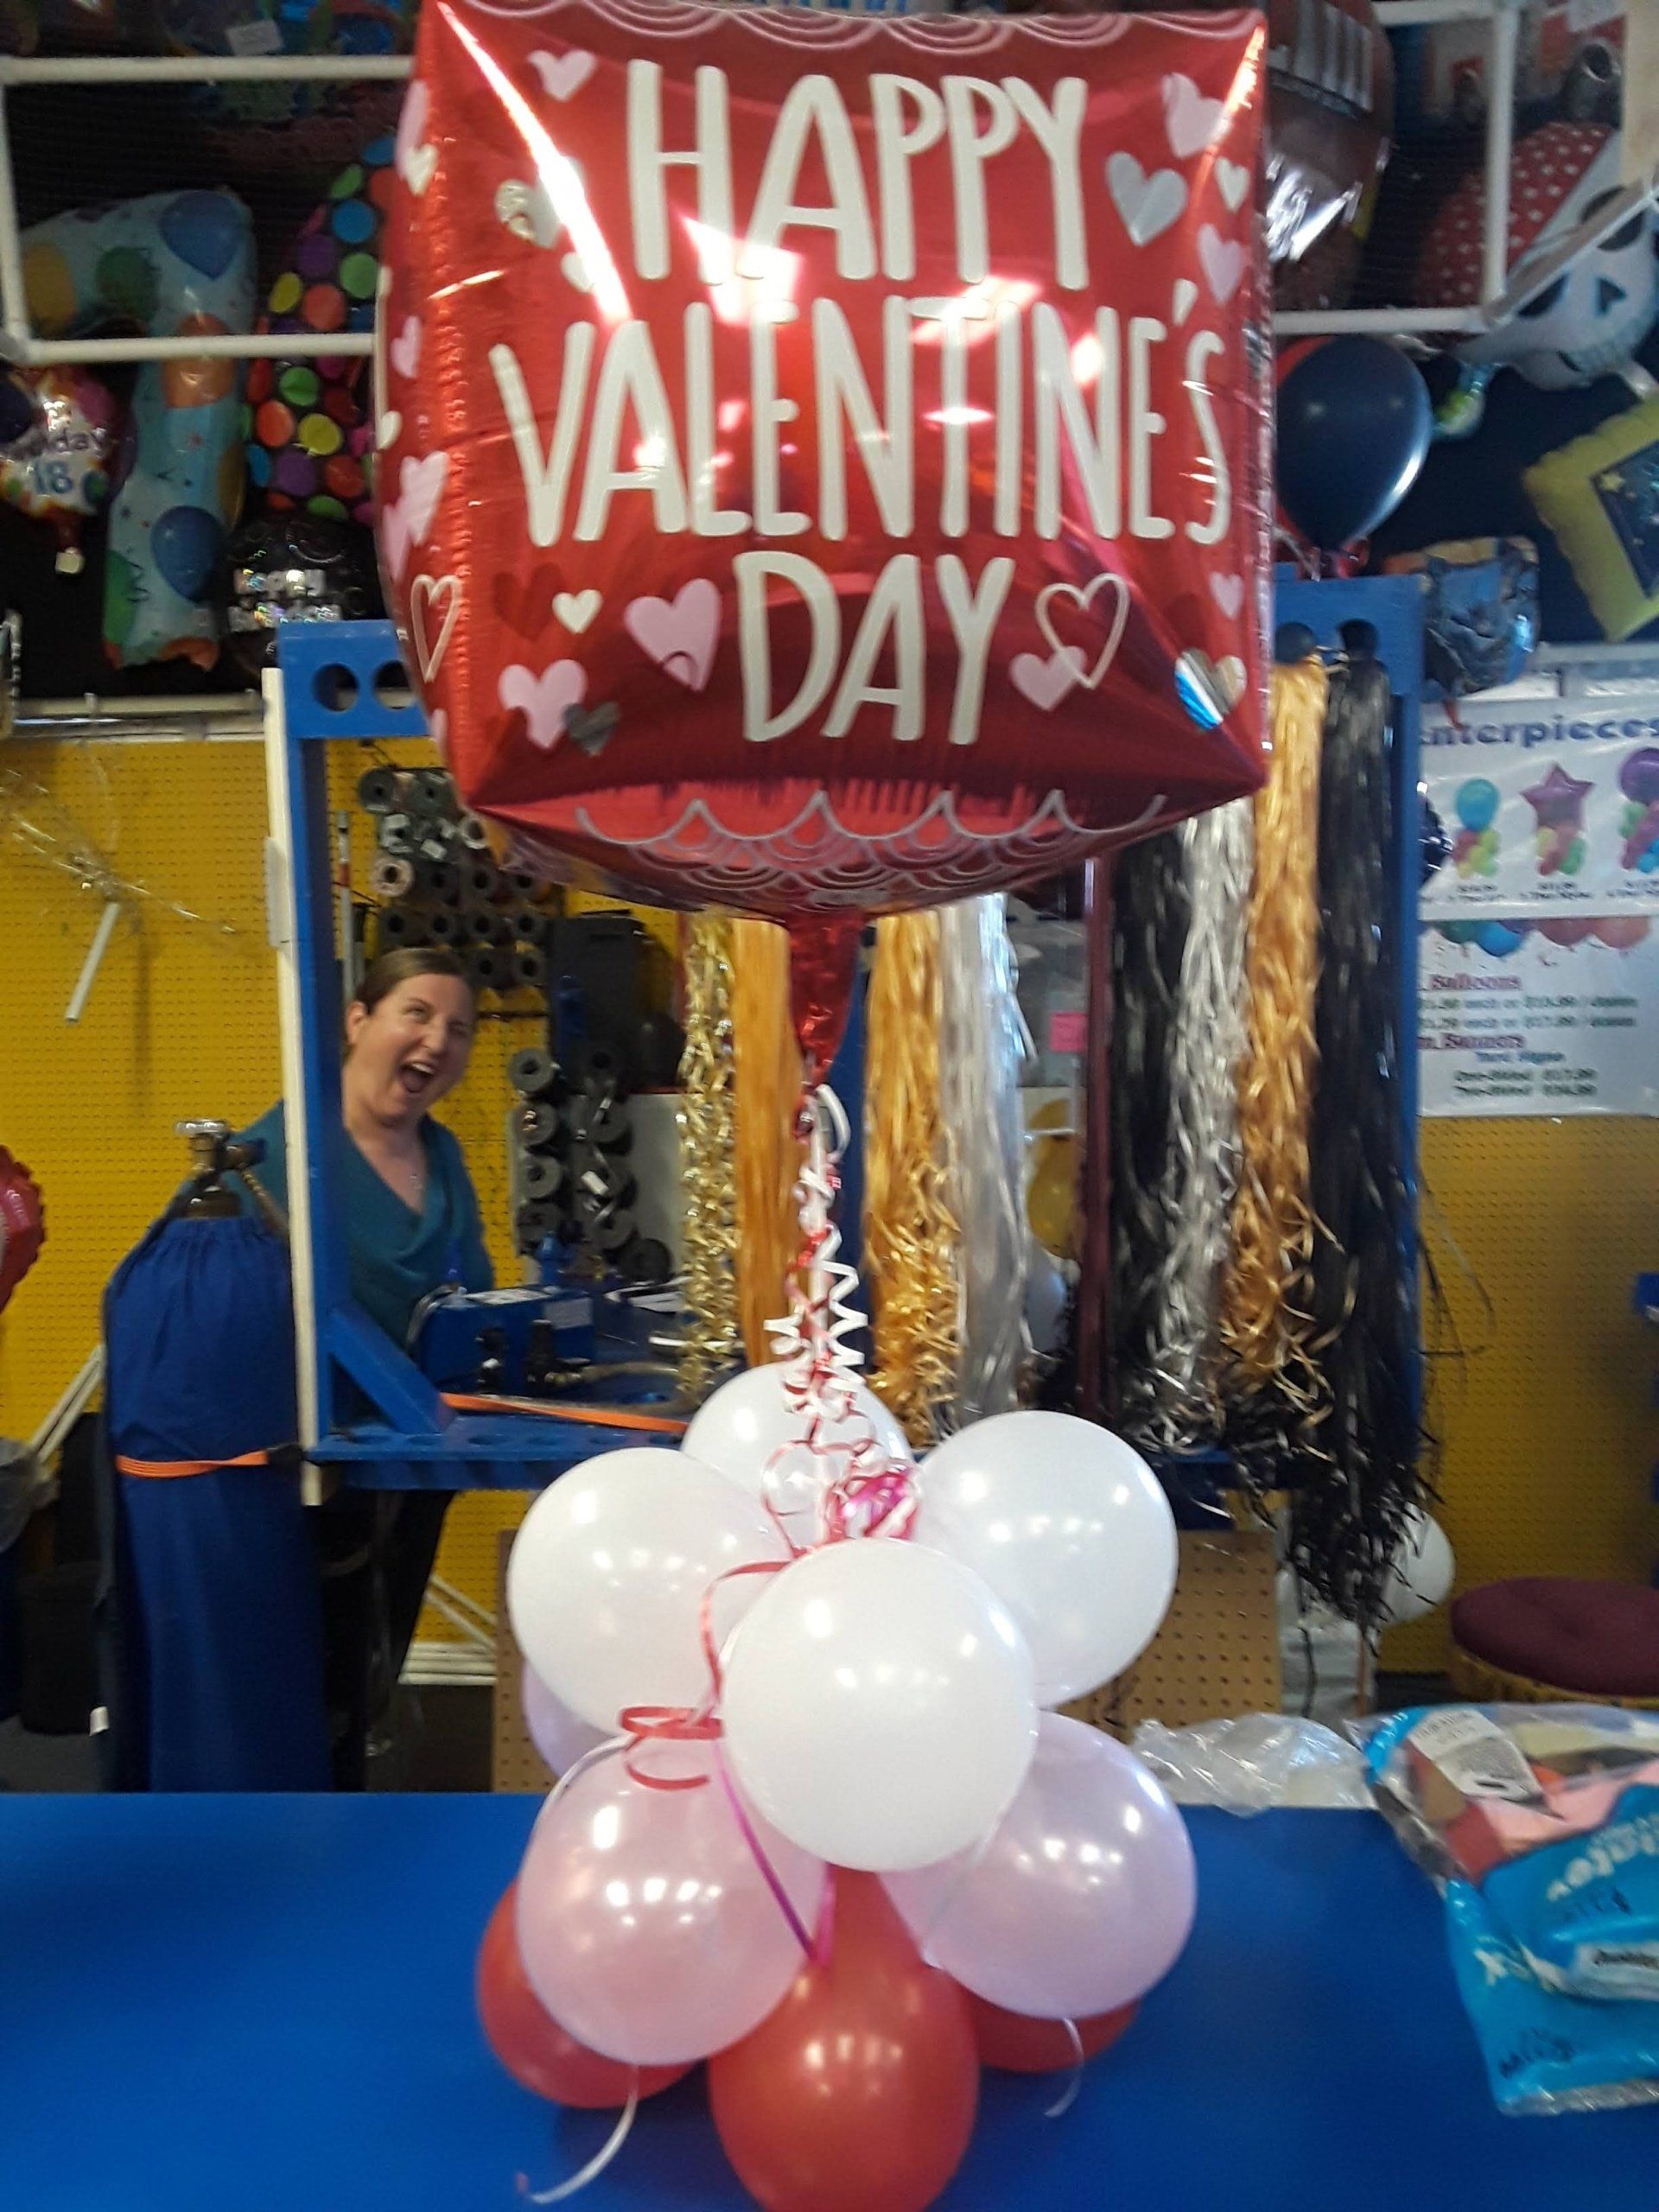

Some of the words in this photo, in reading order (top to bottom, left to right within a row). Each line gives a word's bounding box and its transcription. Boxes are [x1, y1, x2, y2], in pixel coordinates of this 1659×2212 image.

[626, 59, 1087, 292] HAPPY
[489, 278, 1234, 546] VALENTINE'S
[734, 550, 1015, 745] DAY
